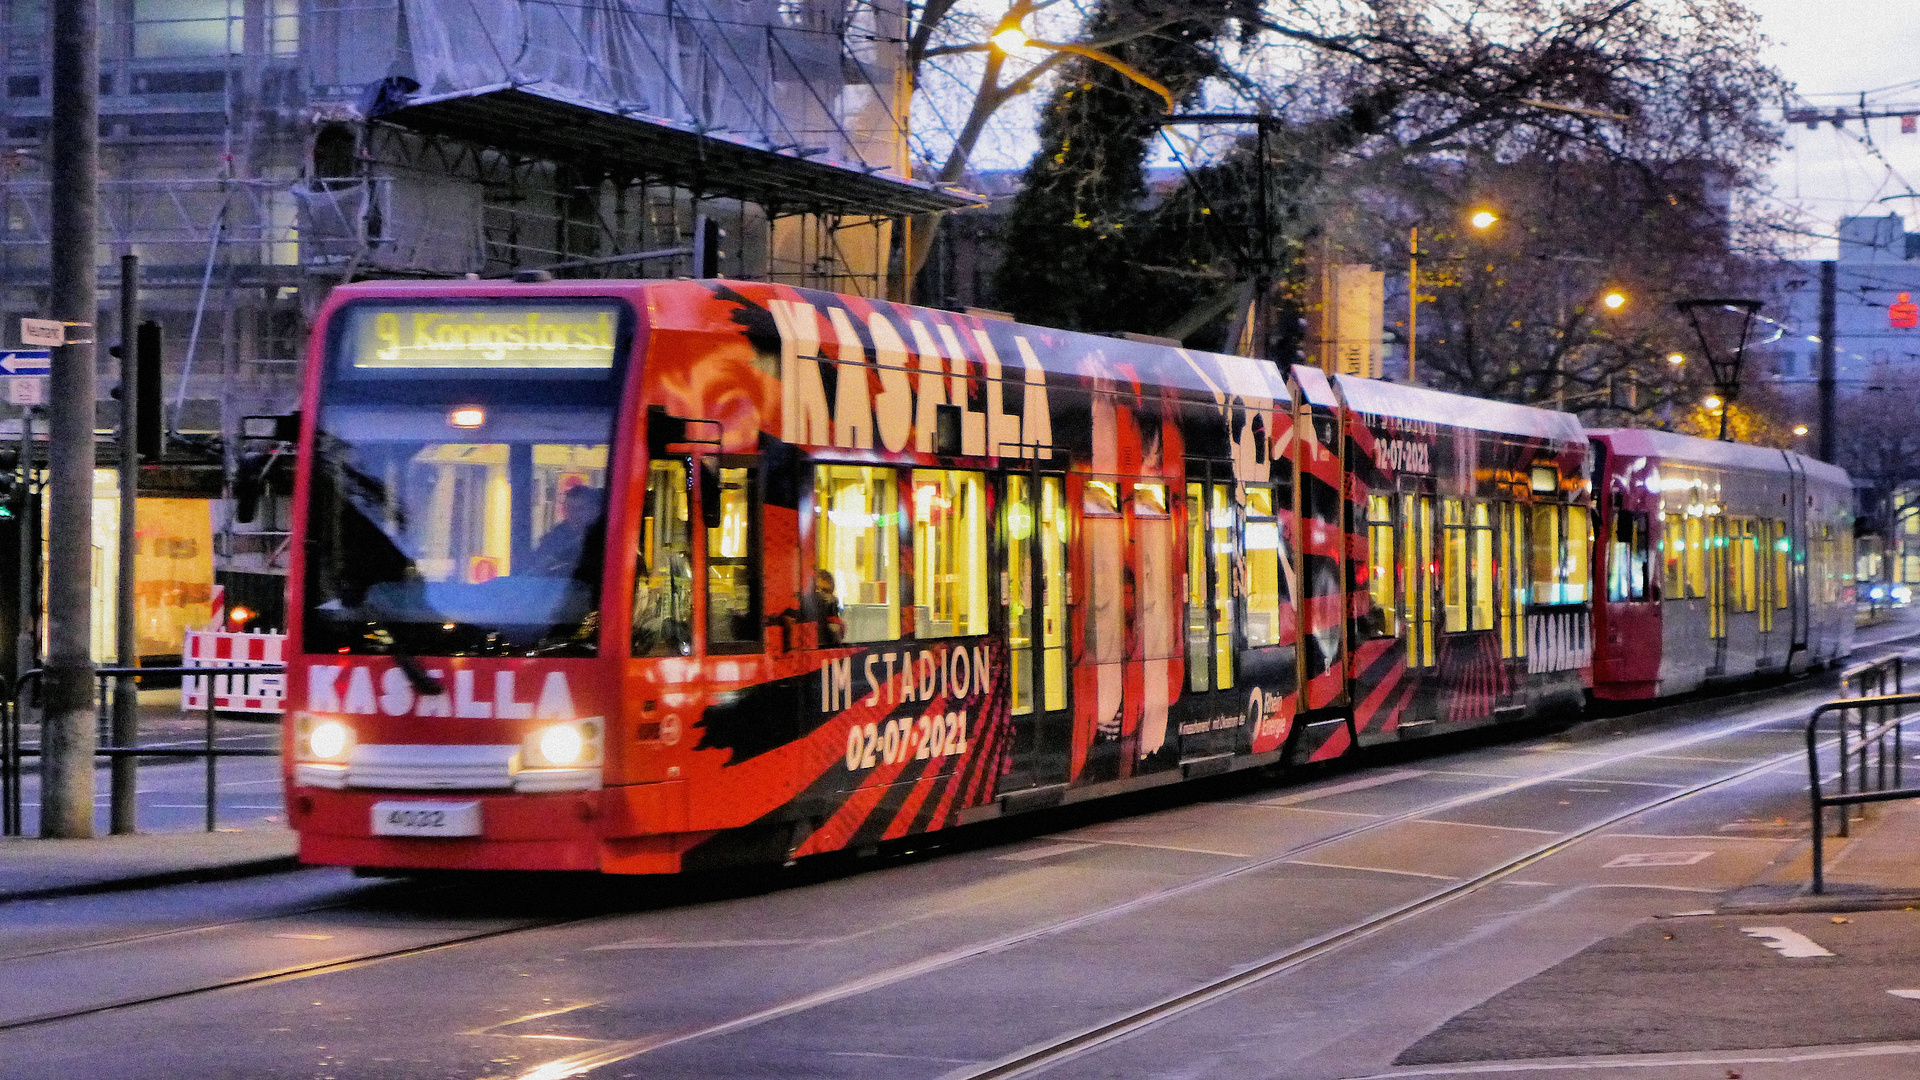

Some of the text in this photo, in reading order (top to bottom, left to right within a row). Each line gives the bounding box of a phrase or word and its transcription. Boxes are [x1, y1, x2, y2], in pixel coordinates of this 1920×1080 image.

[376, 312, 399, 360] 9
[768, 299, 1053, 460] KASALLA
[821, 645, 990, 713] IM STADION
